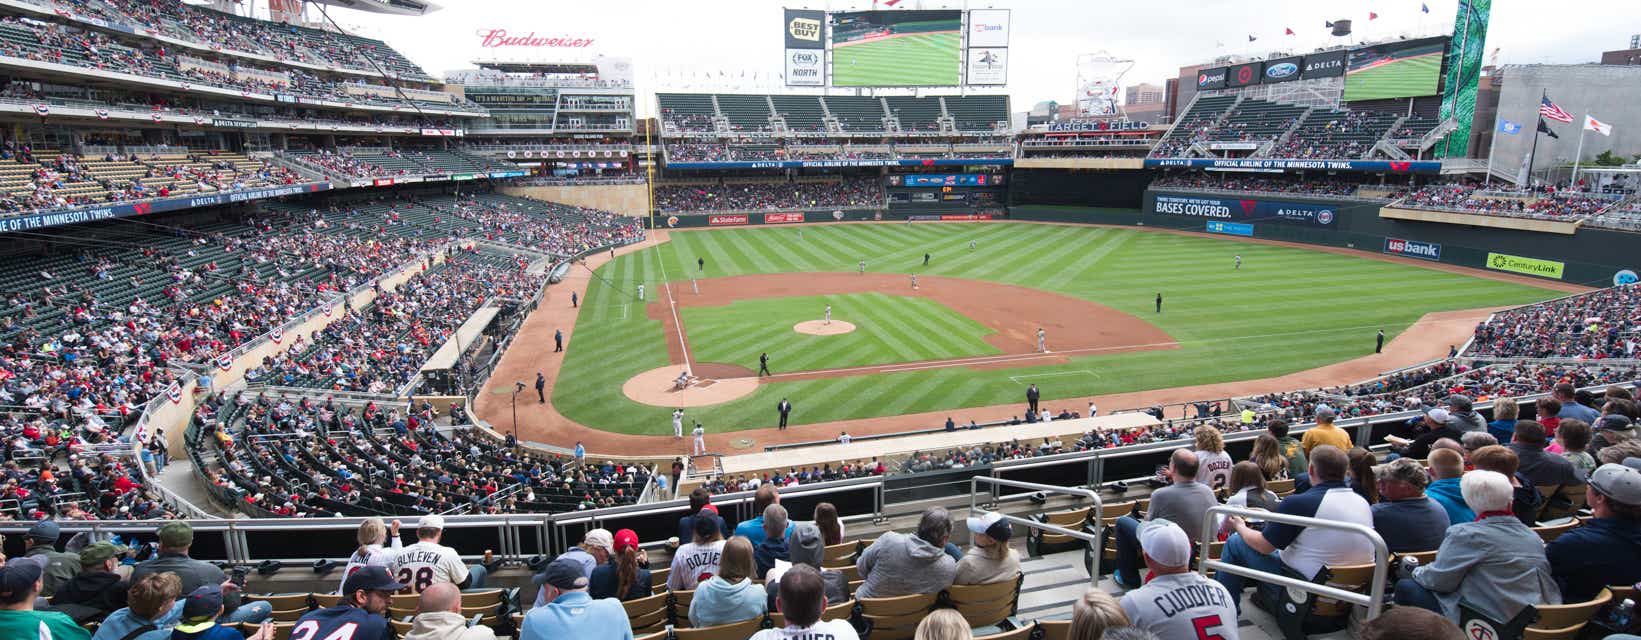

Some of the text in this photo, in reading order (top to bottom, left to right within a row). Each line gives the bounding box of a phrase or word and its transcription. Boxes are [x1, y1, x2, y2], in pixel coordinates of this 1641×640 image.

[794, 22, 819, 30] BEST
[476, 29, 595, 47] Budweiser
[794, 29, 816, 37] BUY
[1315, 60, 1341, 69] DELTA
[792, 68, 817, 76] NORTH
[1207, 74, 1225, 84] pepsi
[1049, 121, 1149, 131] TARGET FIELD
[1240, 160, 1262, 168] AIRLINE
[1287, 161, 1325, 169] MINNESOTA
[196, 197, 215, 206] DELTA
[1156, 202, 1232, 218] BASES COVERED.
[1286, 209, 1313, 217] DELTA
[10, 219, 21, 231] OF
[24, 217, 42, 229] THE
[43, 211, 89, 226] MINNESOTA
[90, 208, 115, 220] TWINS.
[1508, 260, 1557, 273] CenturyLink
[1208, 461, 1230, 472] DOZIER
[398, 551, 442, 567] BLYLEVEN
[686, 552, 720, 570] DOZIE
[398, 567, 434, 593] 28
[1154, 586, 1228, 618] CUDDYER
[1192, 615, 1227, 640] 5
